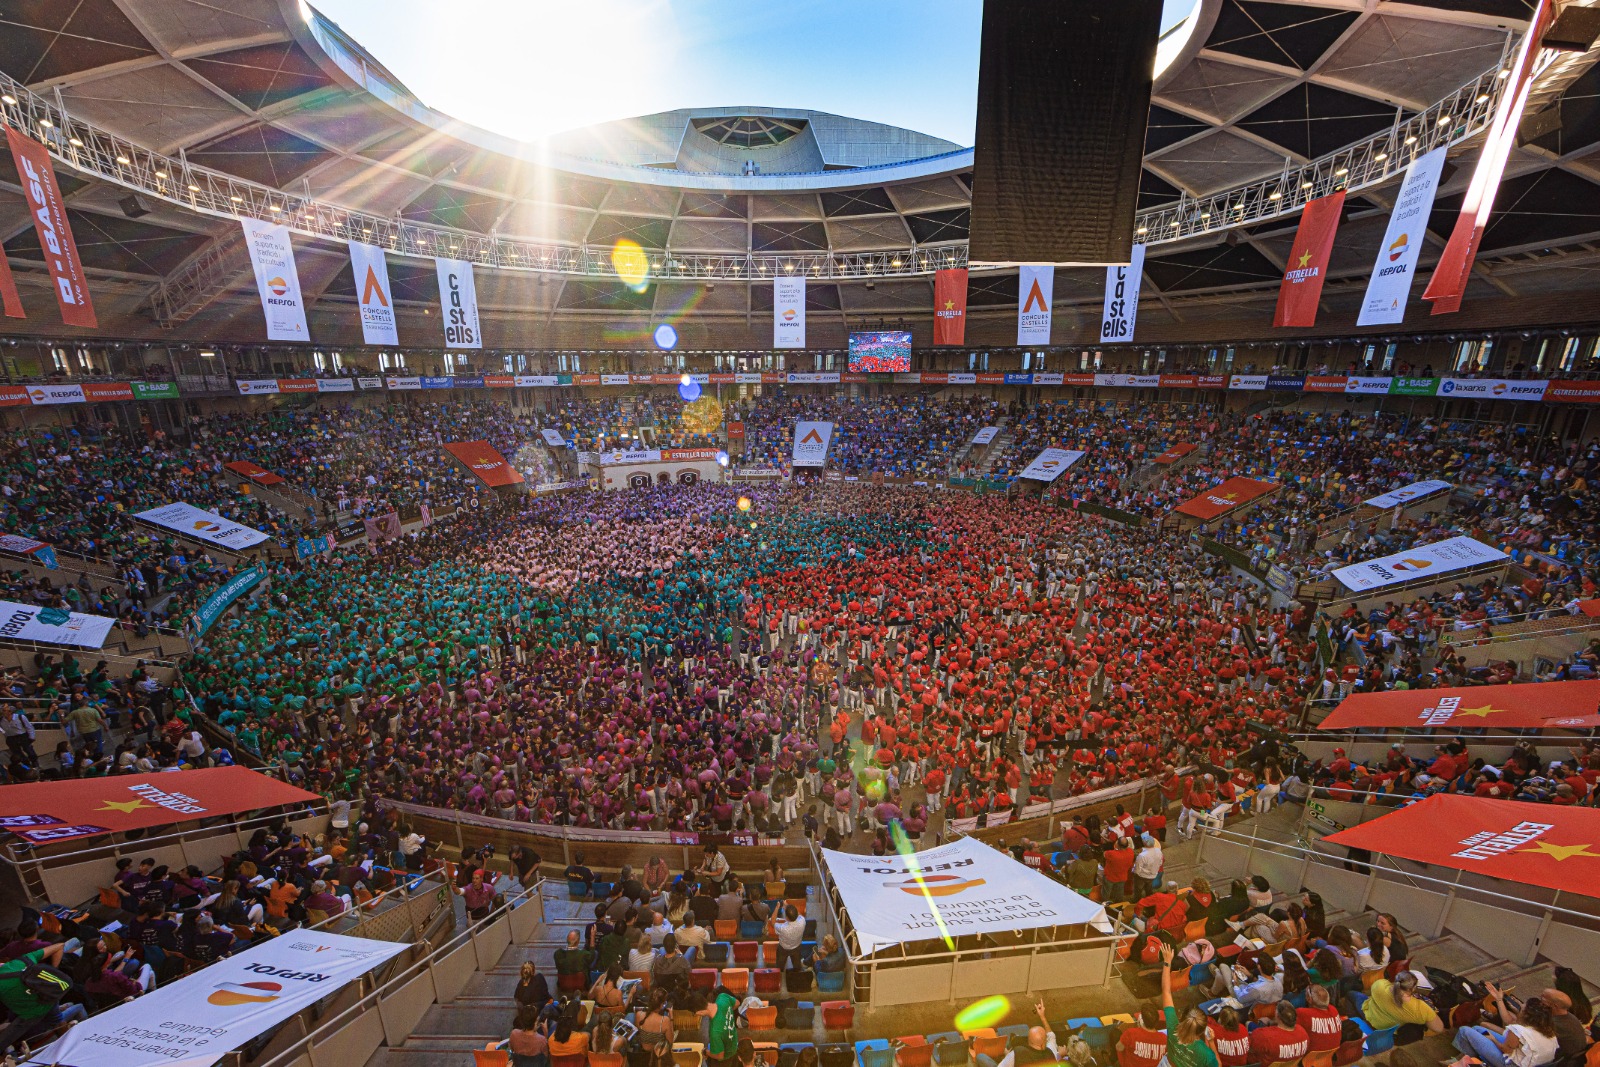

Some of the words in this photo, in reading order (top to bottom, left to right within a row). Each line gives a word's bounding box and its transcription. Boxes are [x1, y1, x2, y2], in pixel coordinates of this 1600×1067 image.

[21, 155, 62, 255] BASF
[40, 165, 65, 235] chemistry
[62, 241, 77, 281] create
[1286, 267, 1319, 280] ESTRELLA
[1379, 264, 1407, 277] REPSOL
[75, 284, 85, 306] We
[268, 298, 296, 307] REPSOL
[362, 307, 391, 315] CONCURS
[450, 308, 466, 325] st
[1110, 299, 1125, 318] st
[363, 314, 392, 322] CASTELLS
[446, 326, 473, 343] ells
[1102, 318, 1127, 337] ells
[51, 390, 83, 398] REPSOL
[672, 451, 700, 459] ESTRELLA
[212, 527, 243, 540] REPSOL
[1368, 563, 1397, 580] REPSOL
[0, 609, 35, 636] REPSOL
[1423, 696, 1461, 726] ESTRELLA
[128, 783, 208, 814] ESTRELLA
[1450, 821, 1554, 860] ESTRELLA
[1459, 830, 1497, 846] DAMM
[857, 858, 975, 875] REPSOL
[936, 898, 1006, 910] cultura
[1010, 894, 1033, 902] la
[922, 906, 996, 920] tradició
[1005, 904, 1026, 912] la
[903, 918, 973, 930] suport
[979, 909, 1057, 924] Donem
[244, 962, 332, 983] REPSOL
[123, 1027, 177, 1045] tradició
[159, 1020, 214, 1036] cultura
[213, 1027, 228, 1039] la
[83, 1032, 138, 1049] suport
[178, 1036, 198, 1047] la
[199, 1039, 209, 1047] a
[134, 1042, 190, 1060] Donem
